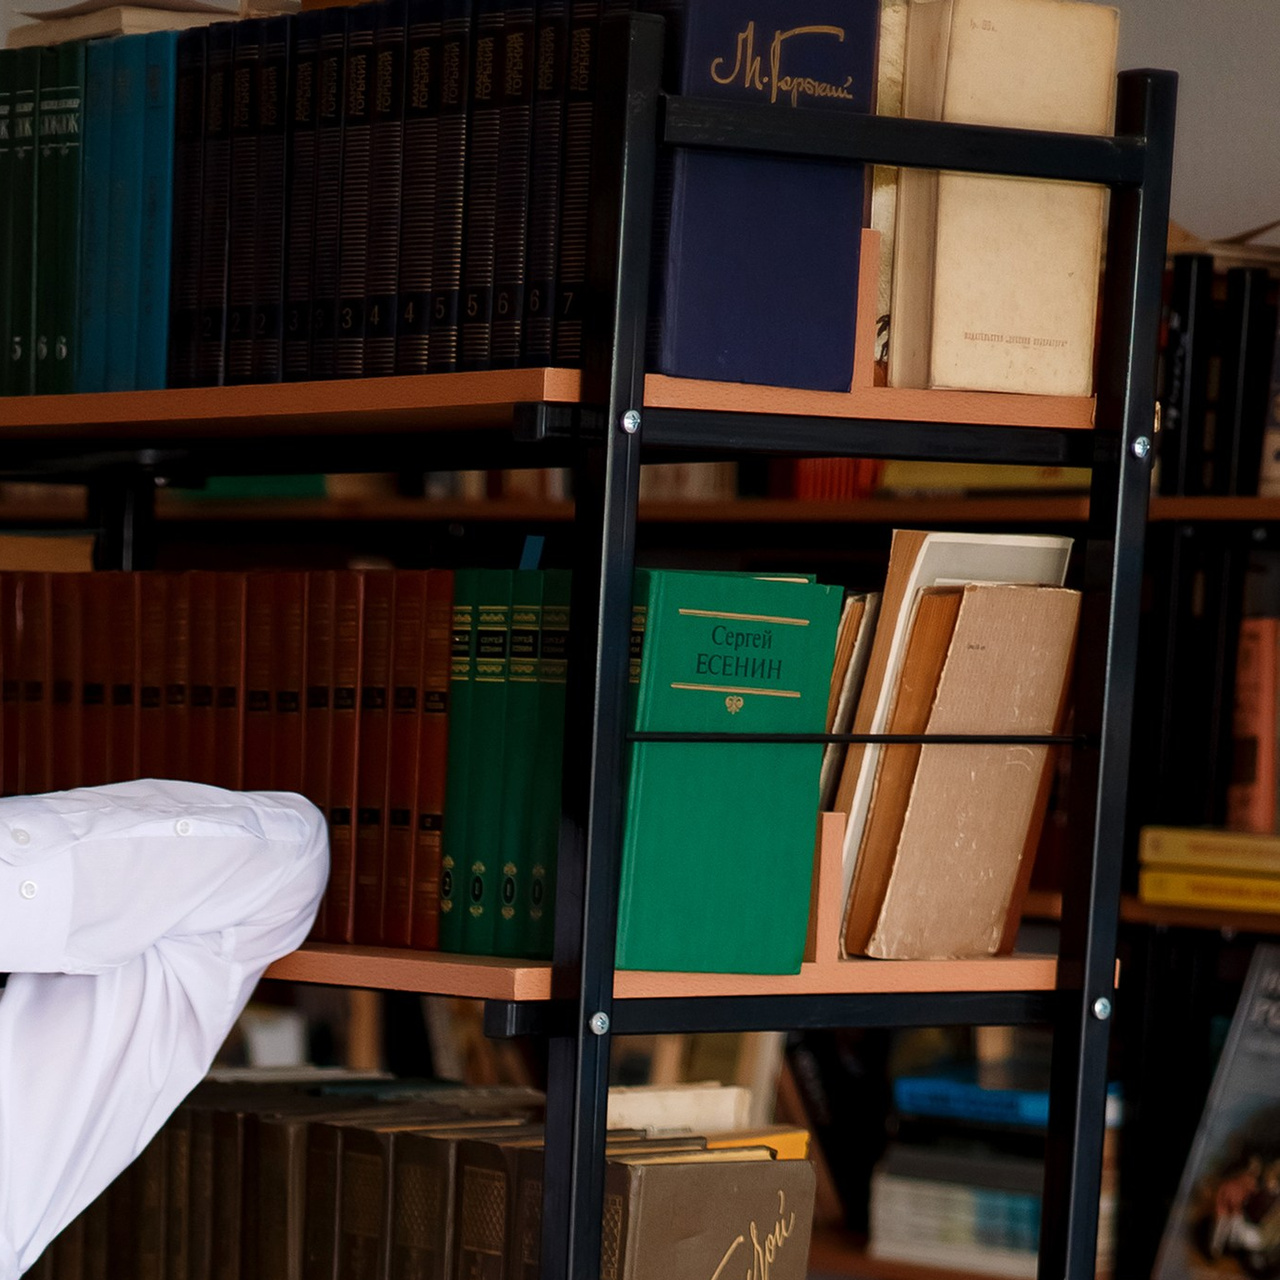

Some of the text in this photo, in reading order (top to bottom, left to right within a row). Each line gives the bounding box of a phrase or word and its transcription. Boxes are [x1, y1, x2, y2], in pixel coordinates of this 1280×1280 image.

[482, 37, 495, 100] ГОРЬКИЙ
[513, 32, 524, 96] ГОРЬКИЙ
[544, 26, 555, 90] ГОРЬКИЙ
[578, 27, 591, 91] ГОРЬКИЙ
[356, 53, 367, 116] ГОРЬКИЙ
[383, 51, 393, 112] ГОРЬКИЙ
[419, 46, 431, 109] ГОРЬКИЙ
[450, 41, 460, 104] ГОРЬКИЙ
[404, 303, 413, 323] 4
[435, 297, 445, 319] 5
[467, 294, 478, 316] 5
[497, 292, 508, 314] 6
[529, 290, 540, 311] 6
[564, 292, 574, 314] 7
[232, 312, 241, 332] 2
[256, 314, 265, 334] 2
[342, 308, 352, 328] 3
[370, 305, 379, 325] 4
[12, 335, 22, 360] 5
[55, 335, 67, 360] 6
[712, 625, 772, 651] Сергей
[696, 653, 783, 680] ЕСЕНИН
